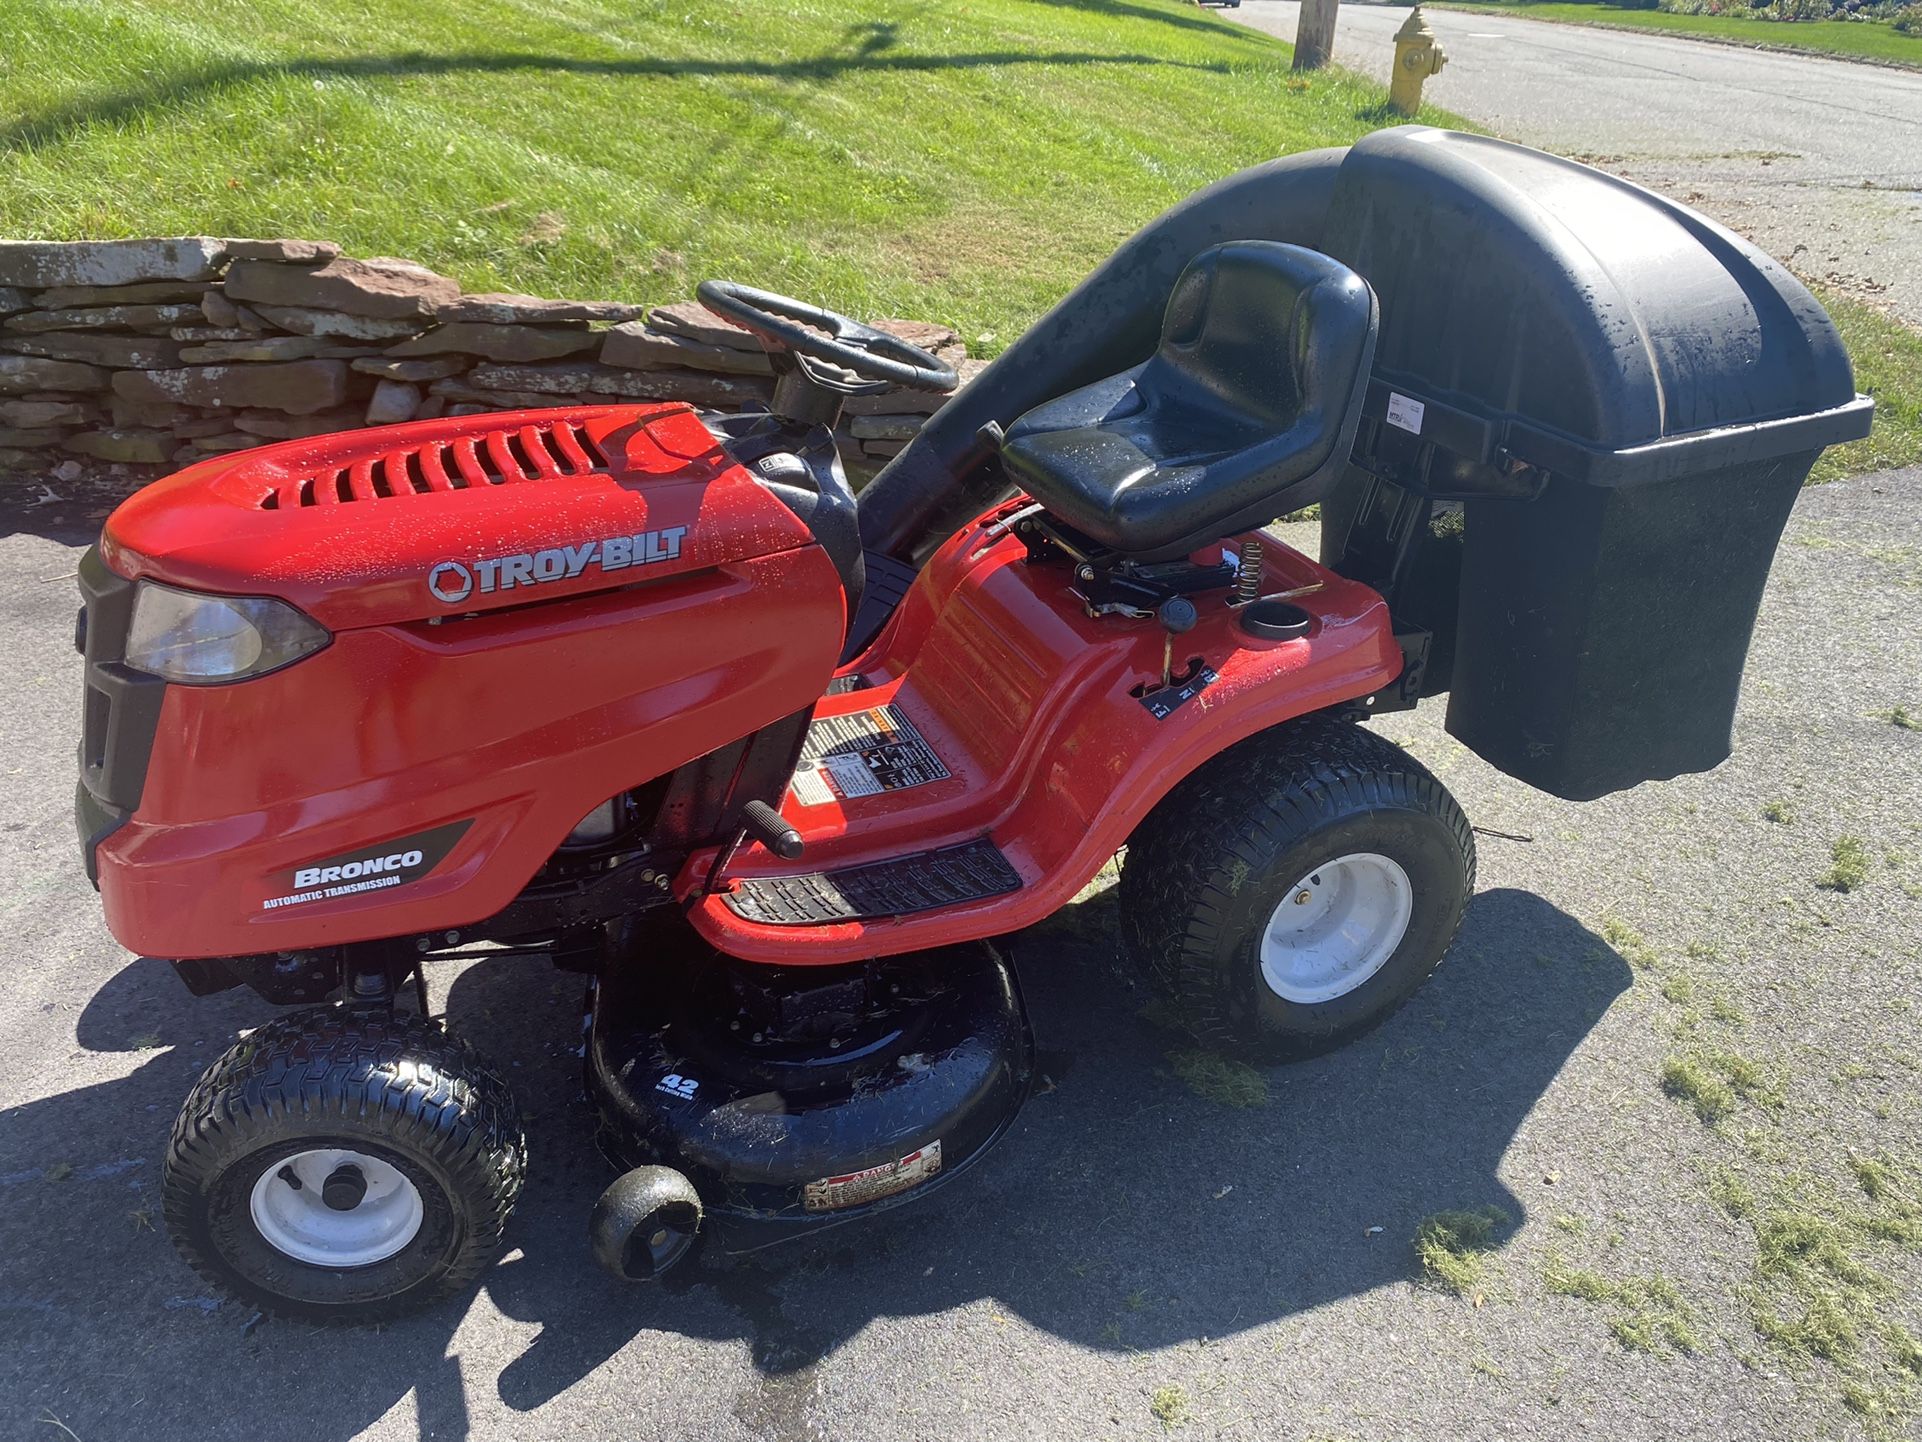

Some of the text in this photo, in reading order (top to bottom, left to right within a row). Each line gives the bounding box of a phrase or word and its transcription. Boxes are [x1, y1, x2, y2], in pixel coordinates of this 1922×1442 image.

[473, 526, 686, 593] TROY-BILT
[1179, 689, 1192, 699] N
[1155, 710, 1167, 718] F
[263, 875, 401, 910] AUTOMATIC TRANSMISSION
[661, 1073, 699, 1094] 42
